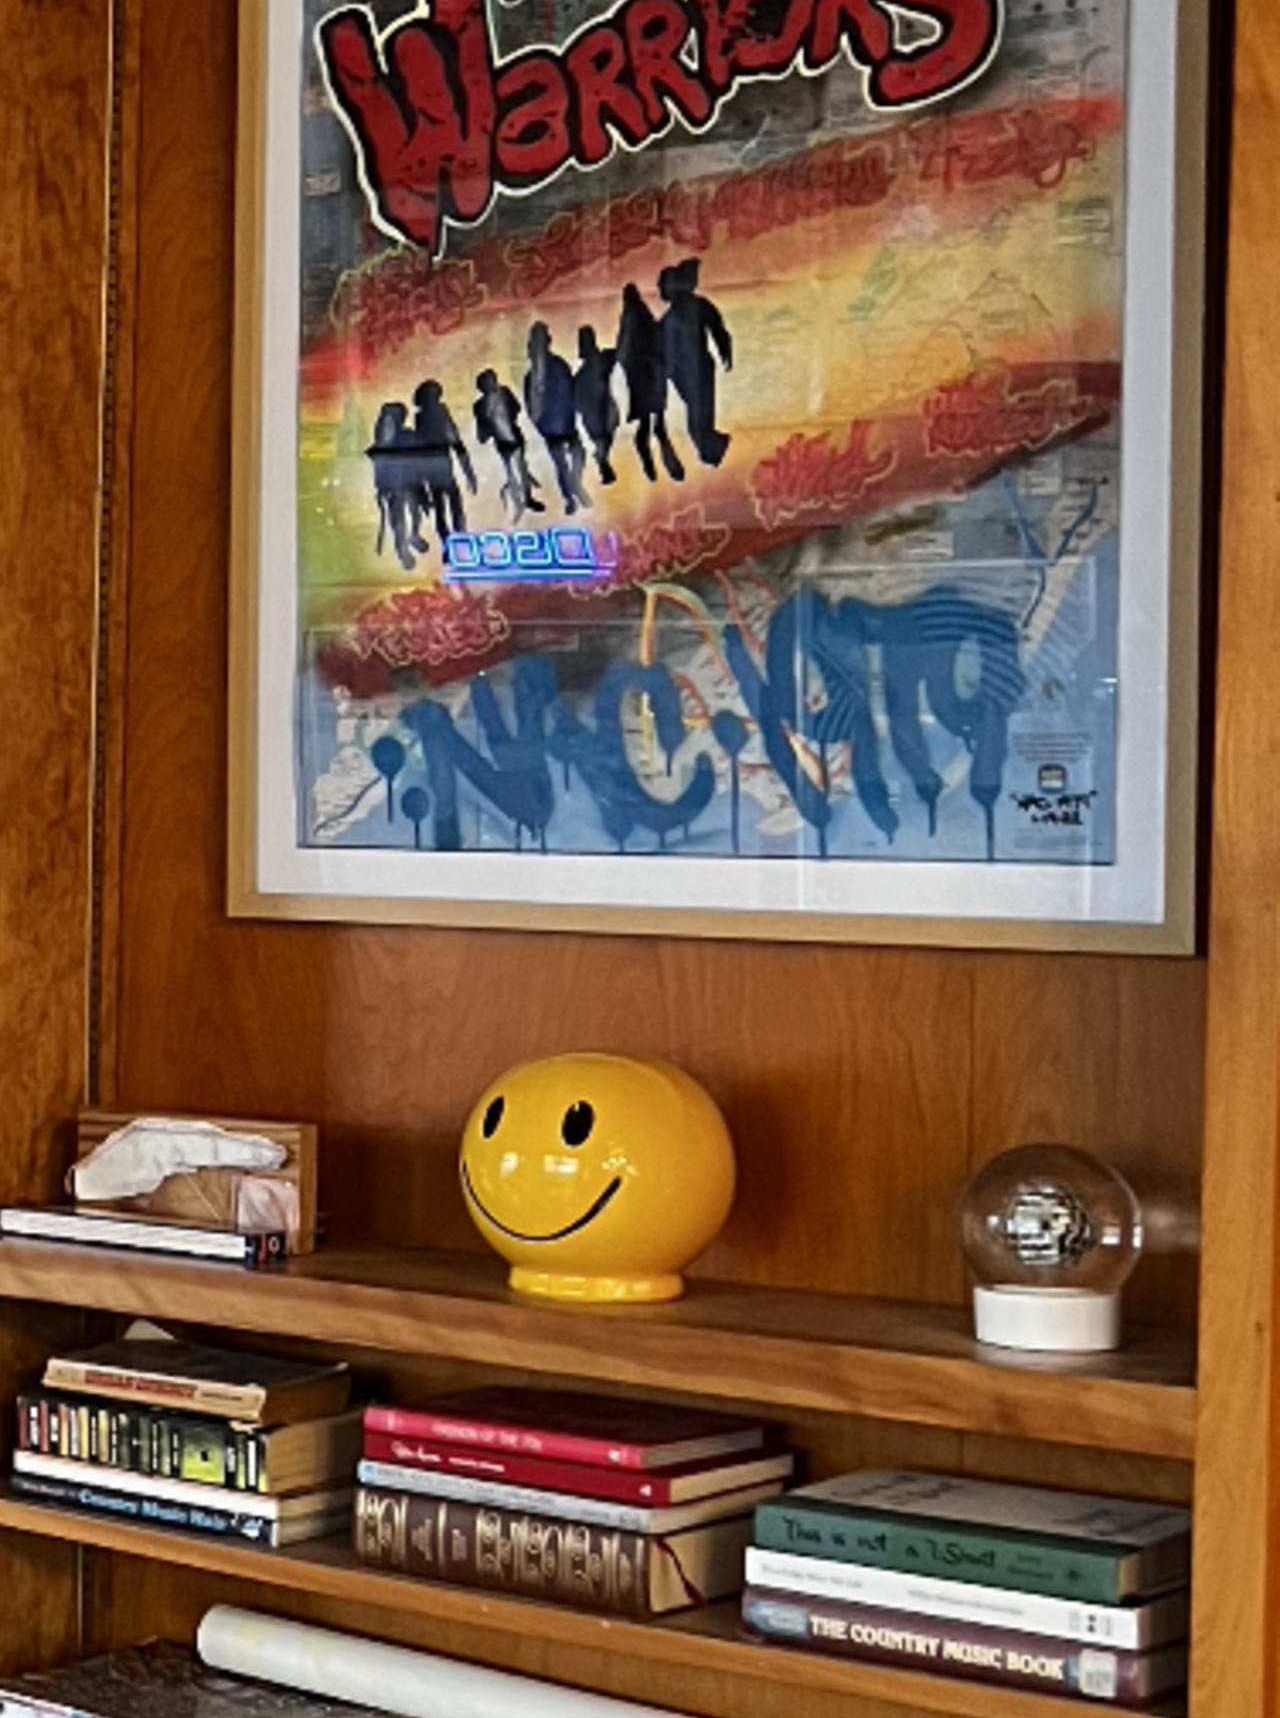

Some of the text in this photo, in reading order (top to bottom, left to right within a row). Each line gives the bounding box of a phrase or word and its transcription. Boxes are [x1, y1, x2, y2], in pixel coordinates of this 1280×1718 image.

[809, 1615, 847, 1640] THE
[849, 1619, 940, 1657] COUNTRY
[941, 1641, 1003, 1669] MUSIC
[1006, 1651, 1065, 1680] BOOK
